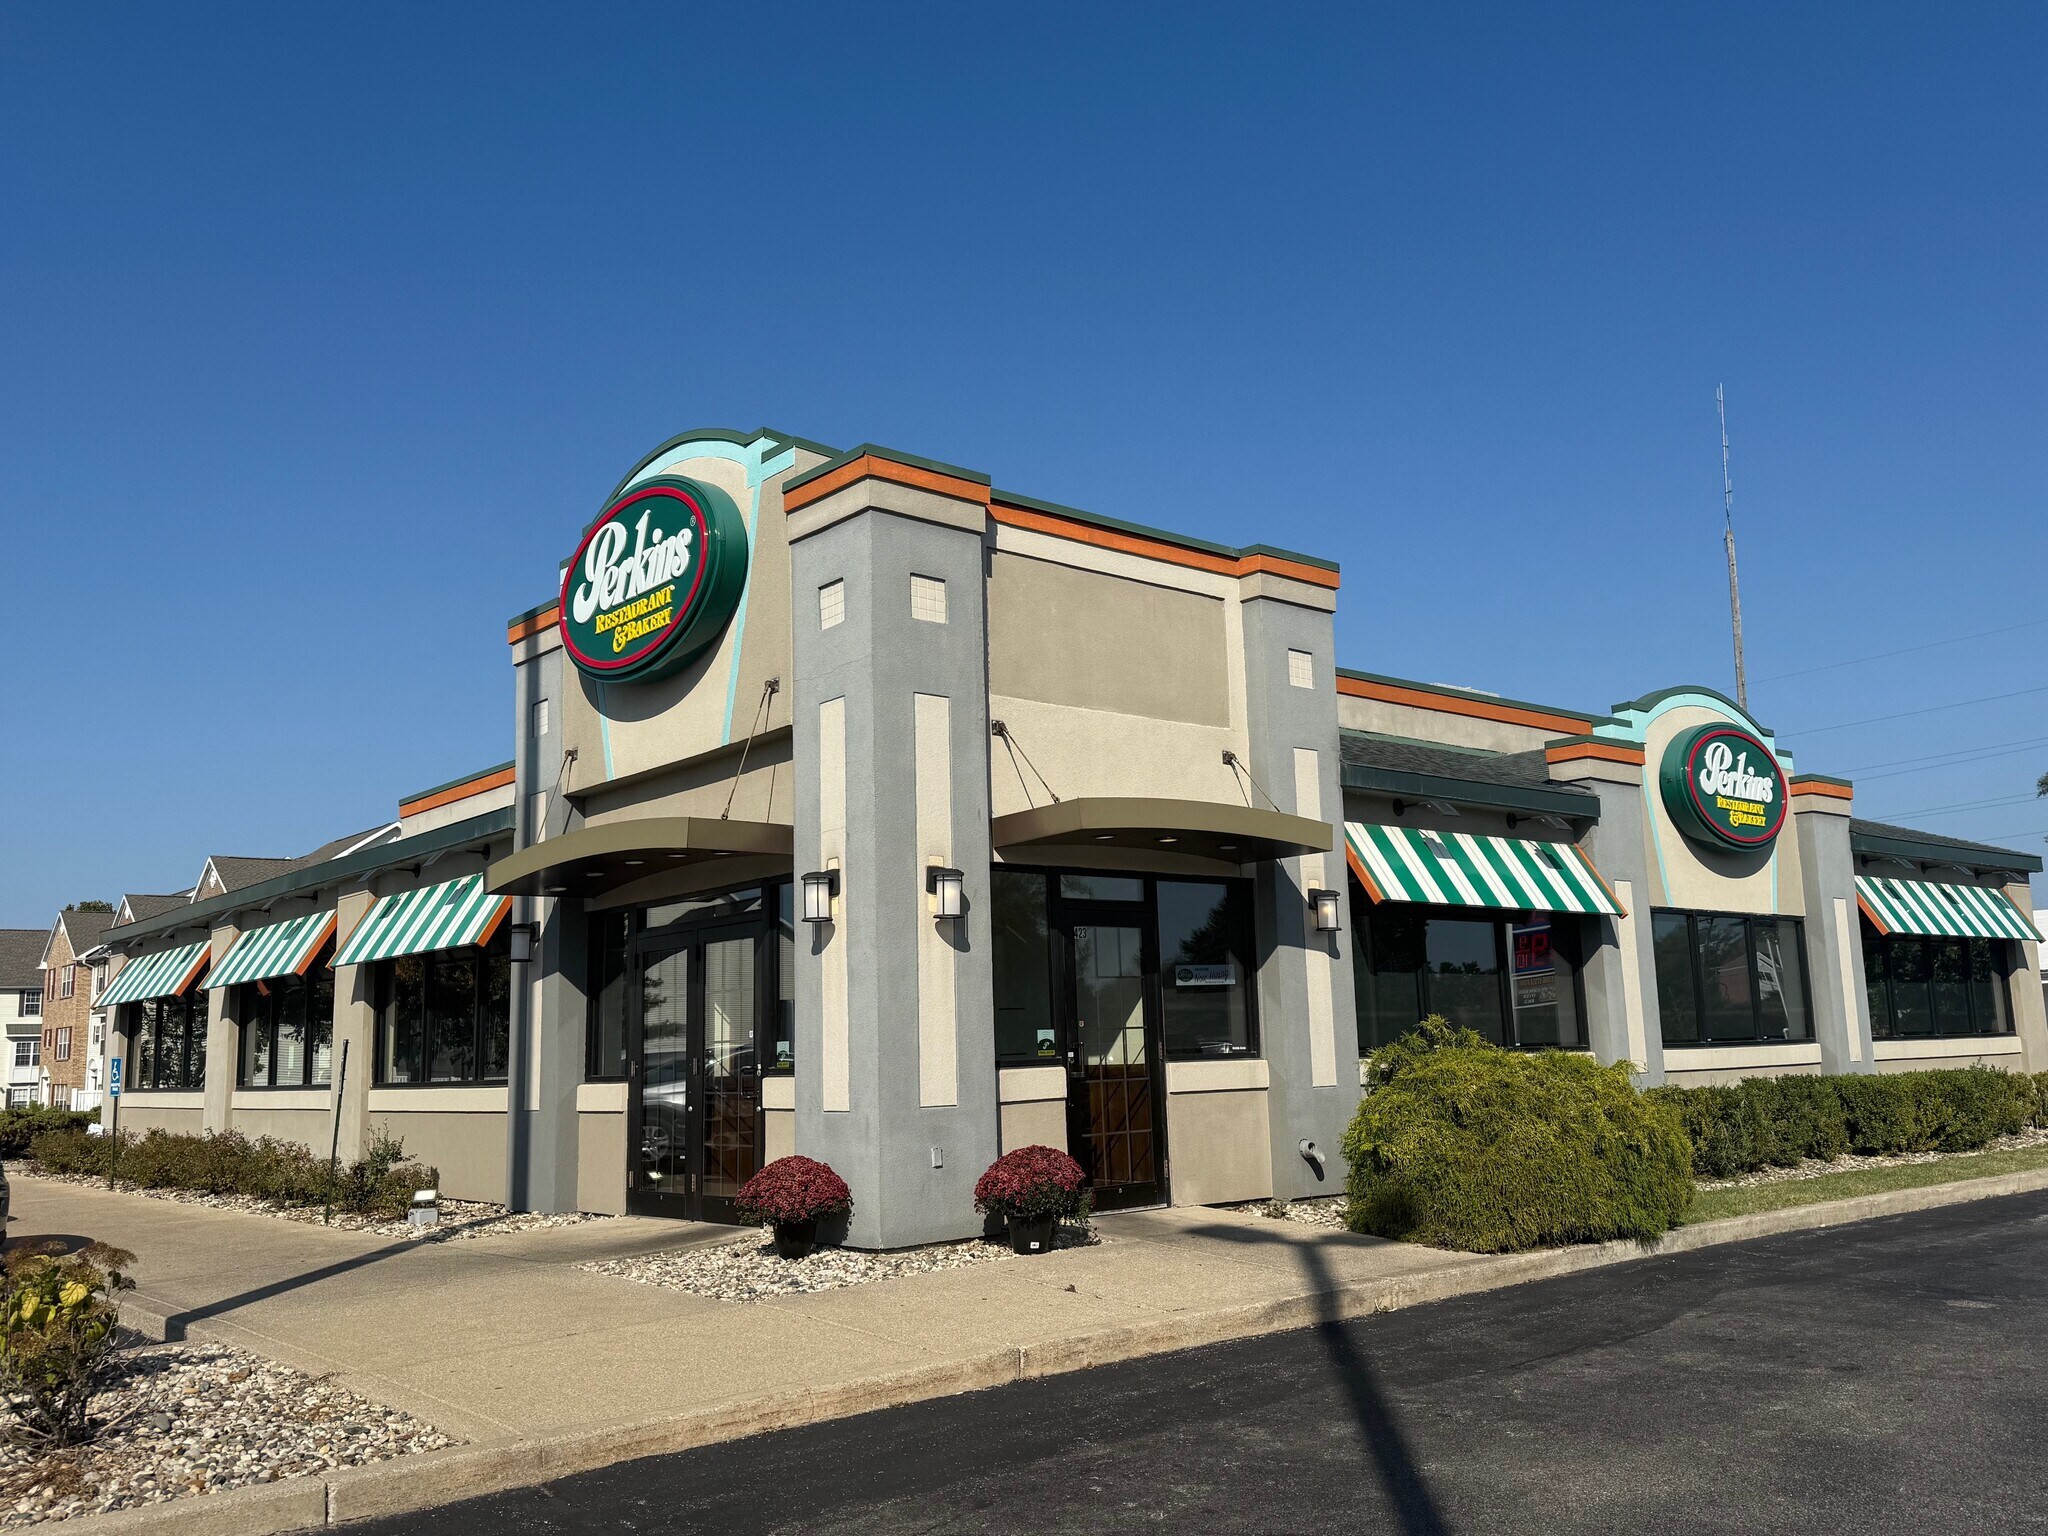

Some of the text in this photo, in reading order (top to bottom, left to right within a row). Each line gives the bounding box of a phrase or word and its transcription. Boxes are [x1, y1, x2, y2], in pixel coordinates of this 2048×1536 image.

[573, 510, 692, 624] Perkins
[595, 585, 675, 634] RESTAURANT
[1699, 742, 1773, 803] Perkins
